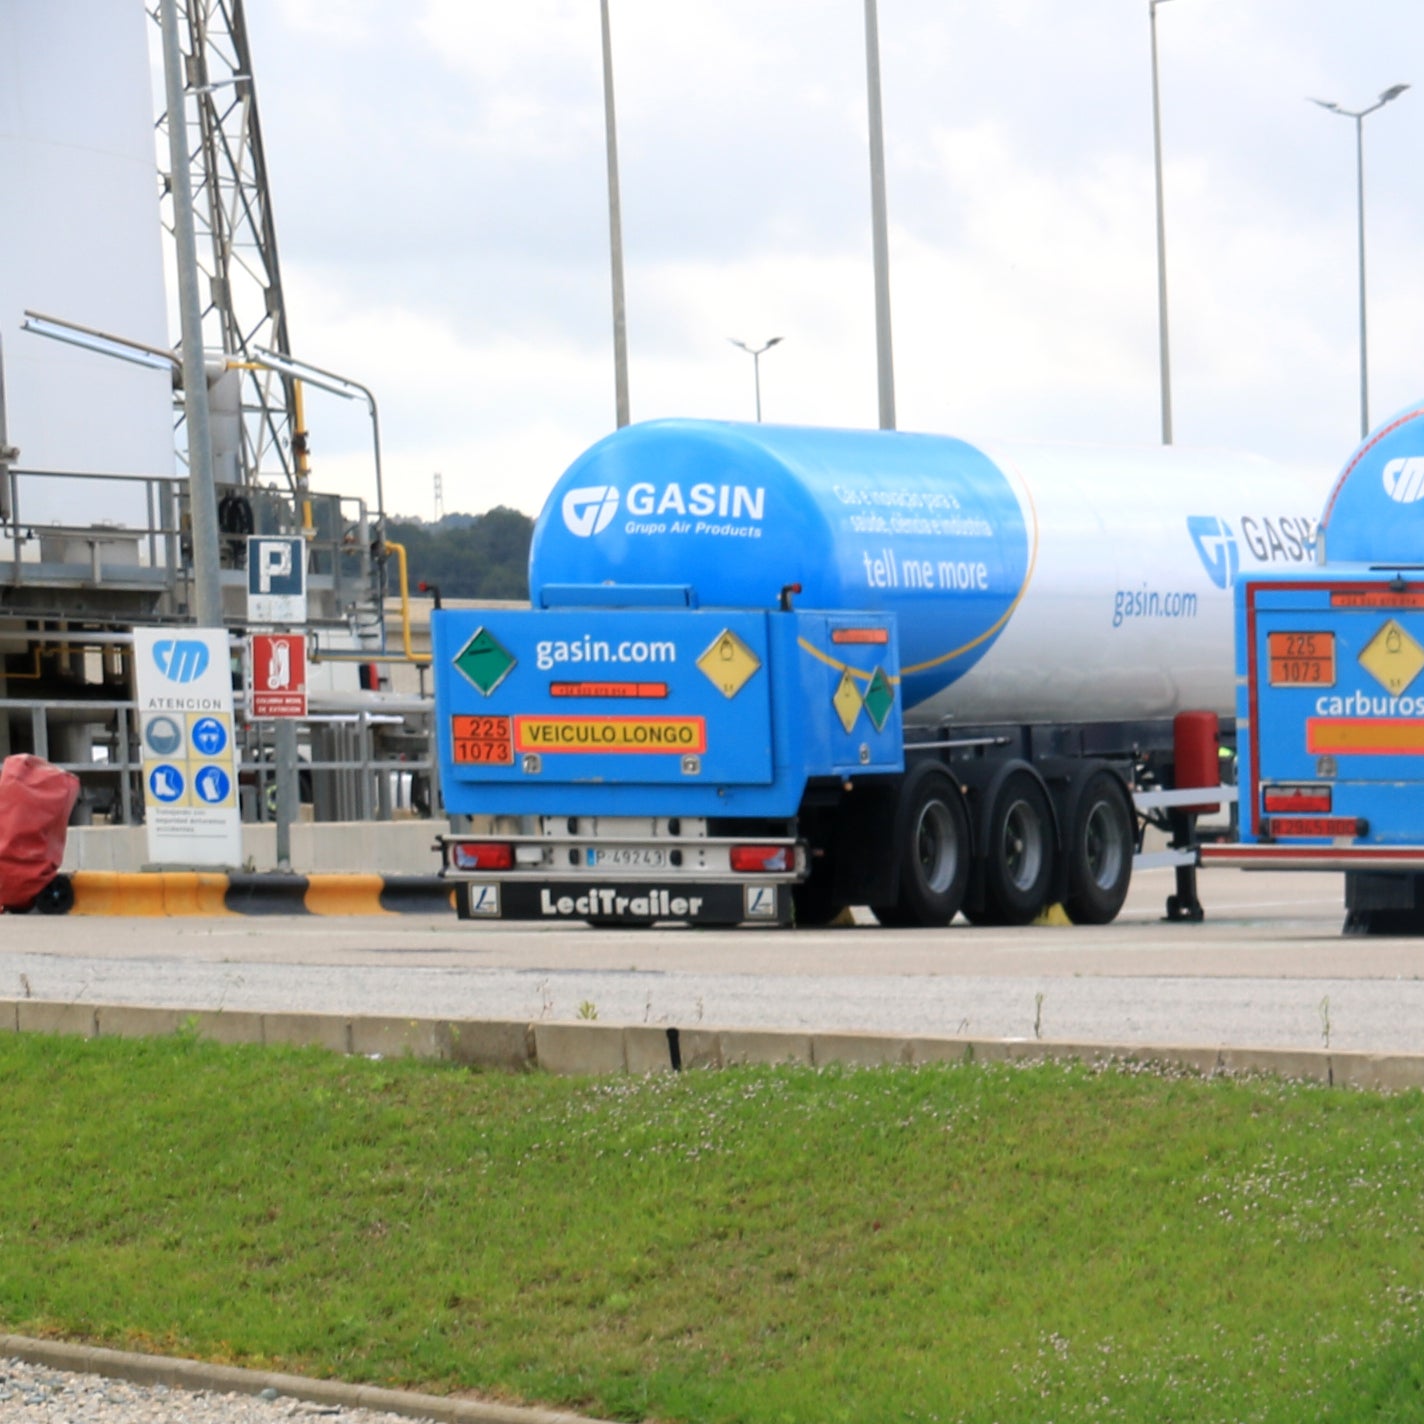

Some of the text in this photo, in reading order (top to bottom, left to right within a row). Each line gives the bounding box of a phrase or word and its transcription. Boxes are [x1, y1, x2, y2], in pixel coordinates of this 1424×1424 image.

[626, 482, 765, 520] GASIN
[625, 521, 762, 538] Grupo Air Products
[259, 542, 292, 592] P
[863, 549, 988, 590] tell me more
[1112, 582, 1197, 628] gasin.com
[536, 635, 676, 670] gasin.com
[1286, 636, 1316, 656] 225
[1282, 662, 1321, 682] 1073
[149, 698, 222, 709] ATENCION
[469, 719, 508, 737] 225
[528, 724, 693, 744] VEICULO LONGO
[459, 742, 508, 761] 1073
[540, 888, 703, 915] LeciTrailer
